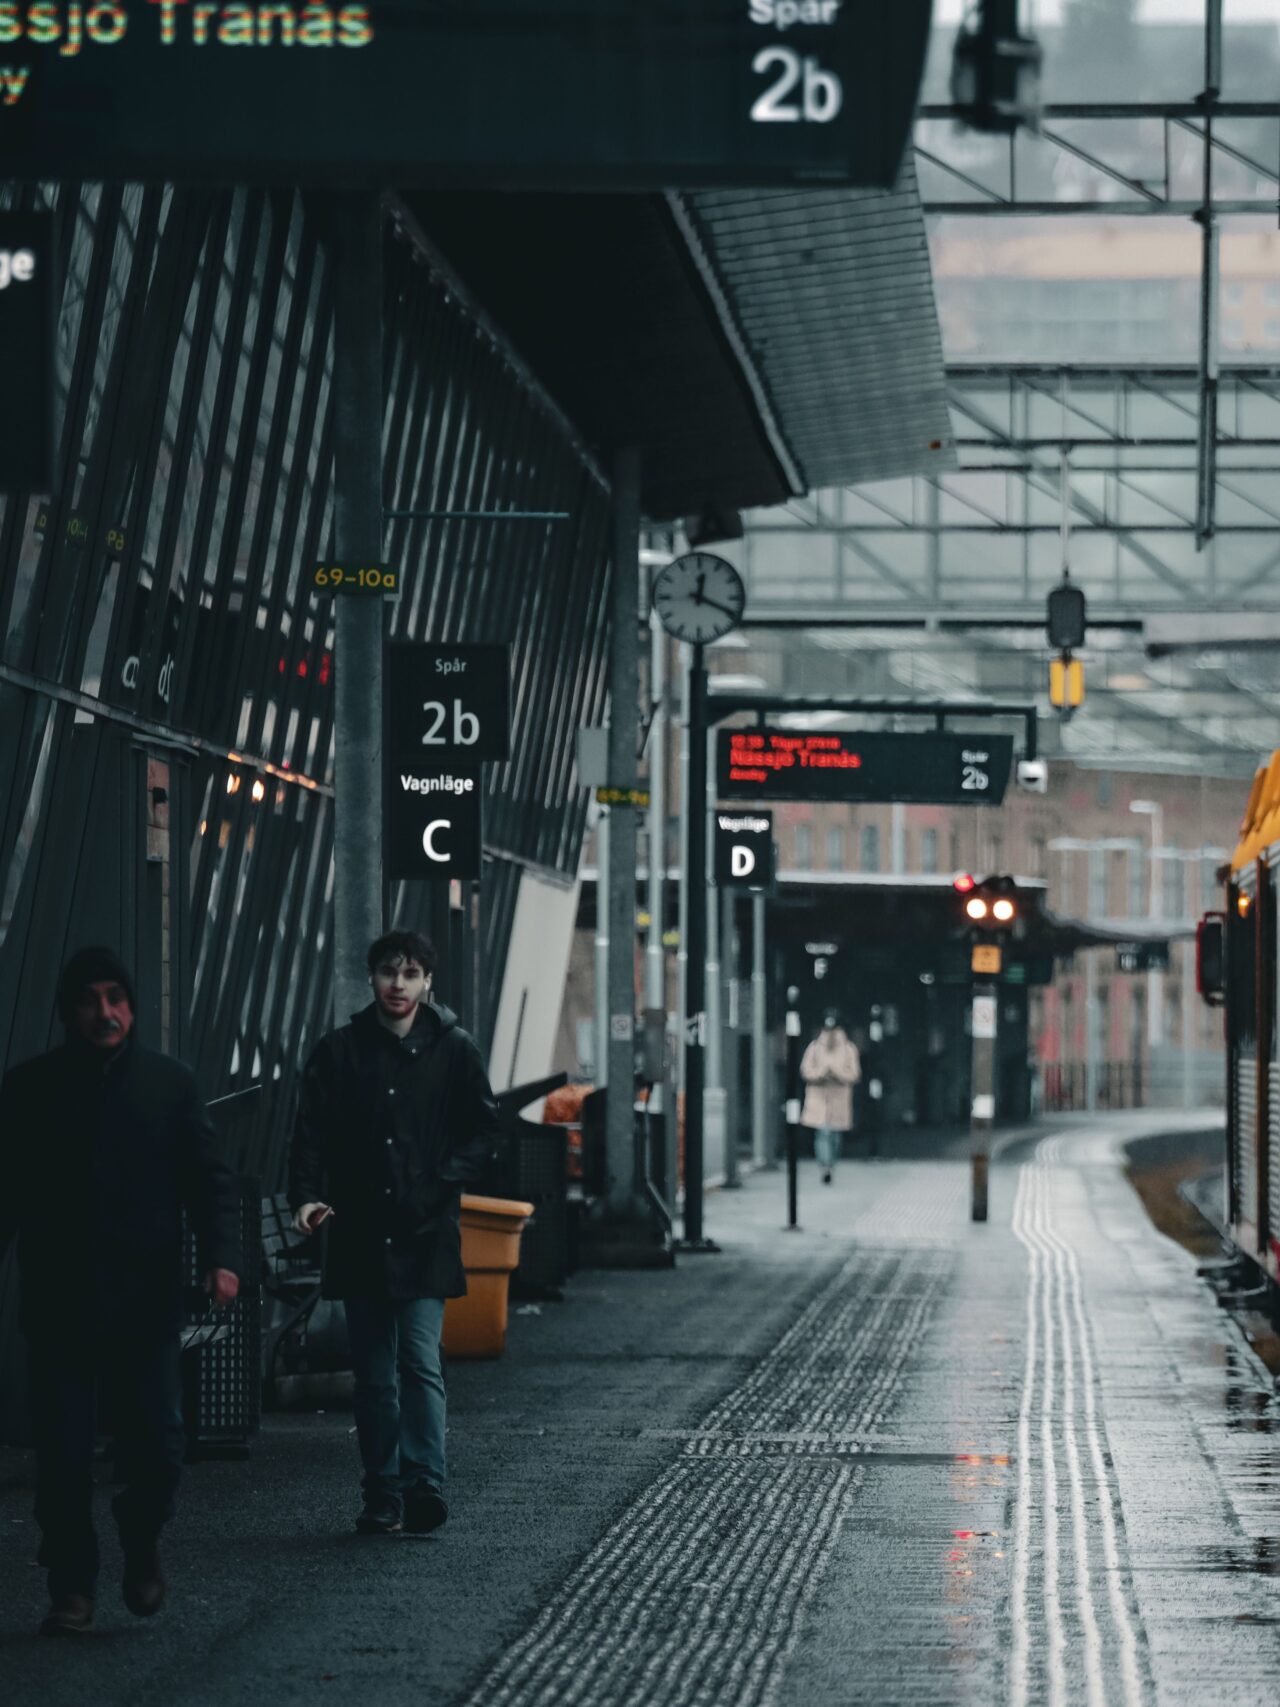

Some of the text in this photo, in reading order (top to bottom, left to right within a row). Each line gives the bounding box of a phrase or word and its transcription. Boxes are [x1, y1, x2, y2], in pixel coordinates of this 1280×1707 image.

[750, 46, 843, 122] 2b
[315, 567, 396, 588] 69-10a
[435, 658, 467, 675] Spår
[422, 699, 480, 745] 2b
[400, 775, 474, 795] Vagnläge
[961, 765, 989, 790] 2b
[422, 819, 452, 862] C
[731, 845, 756, 877] D
